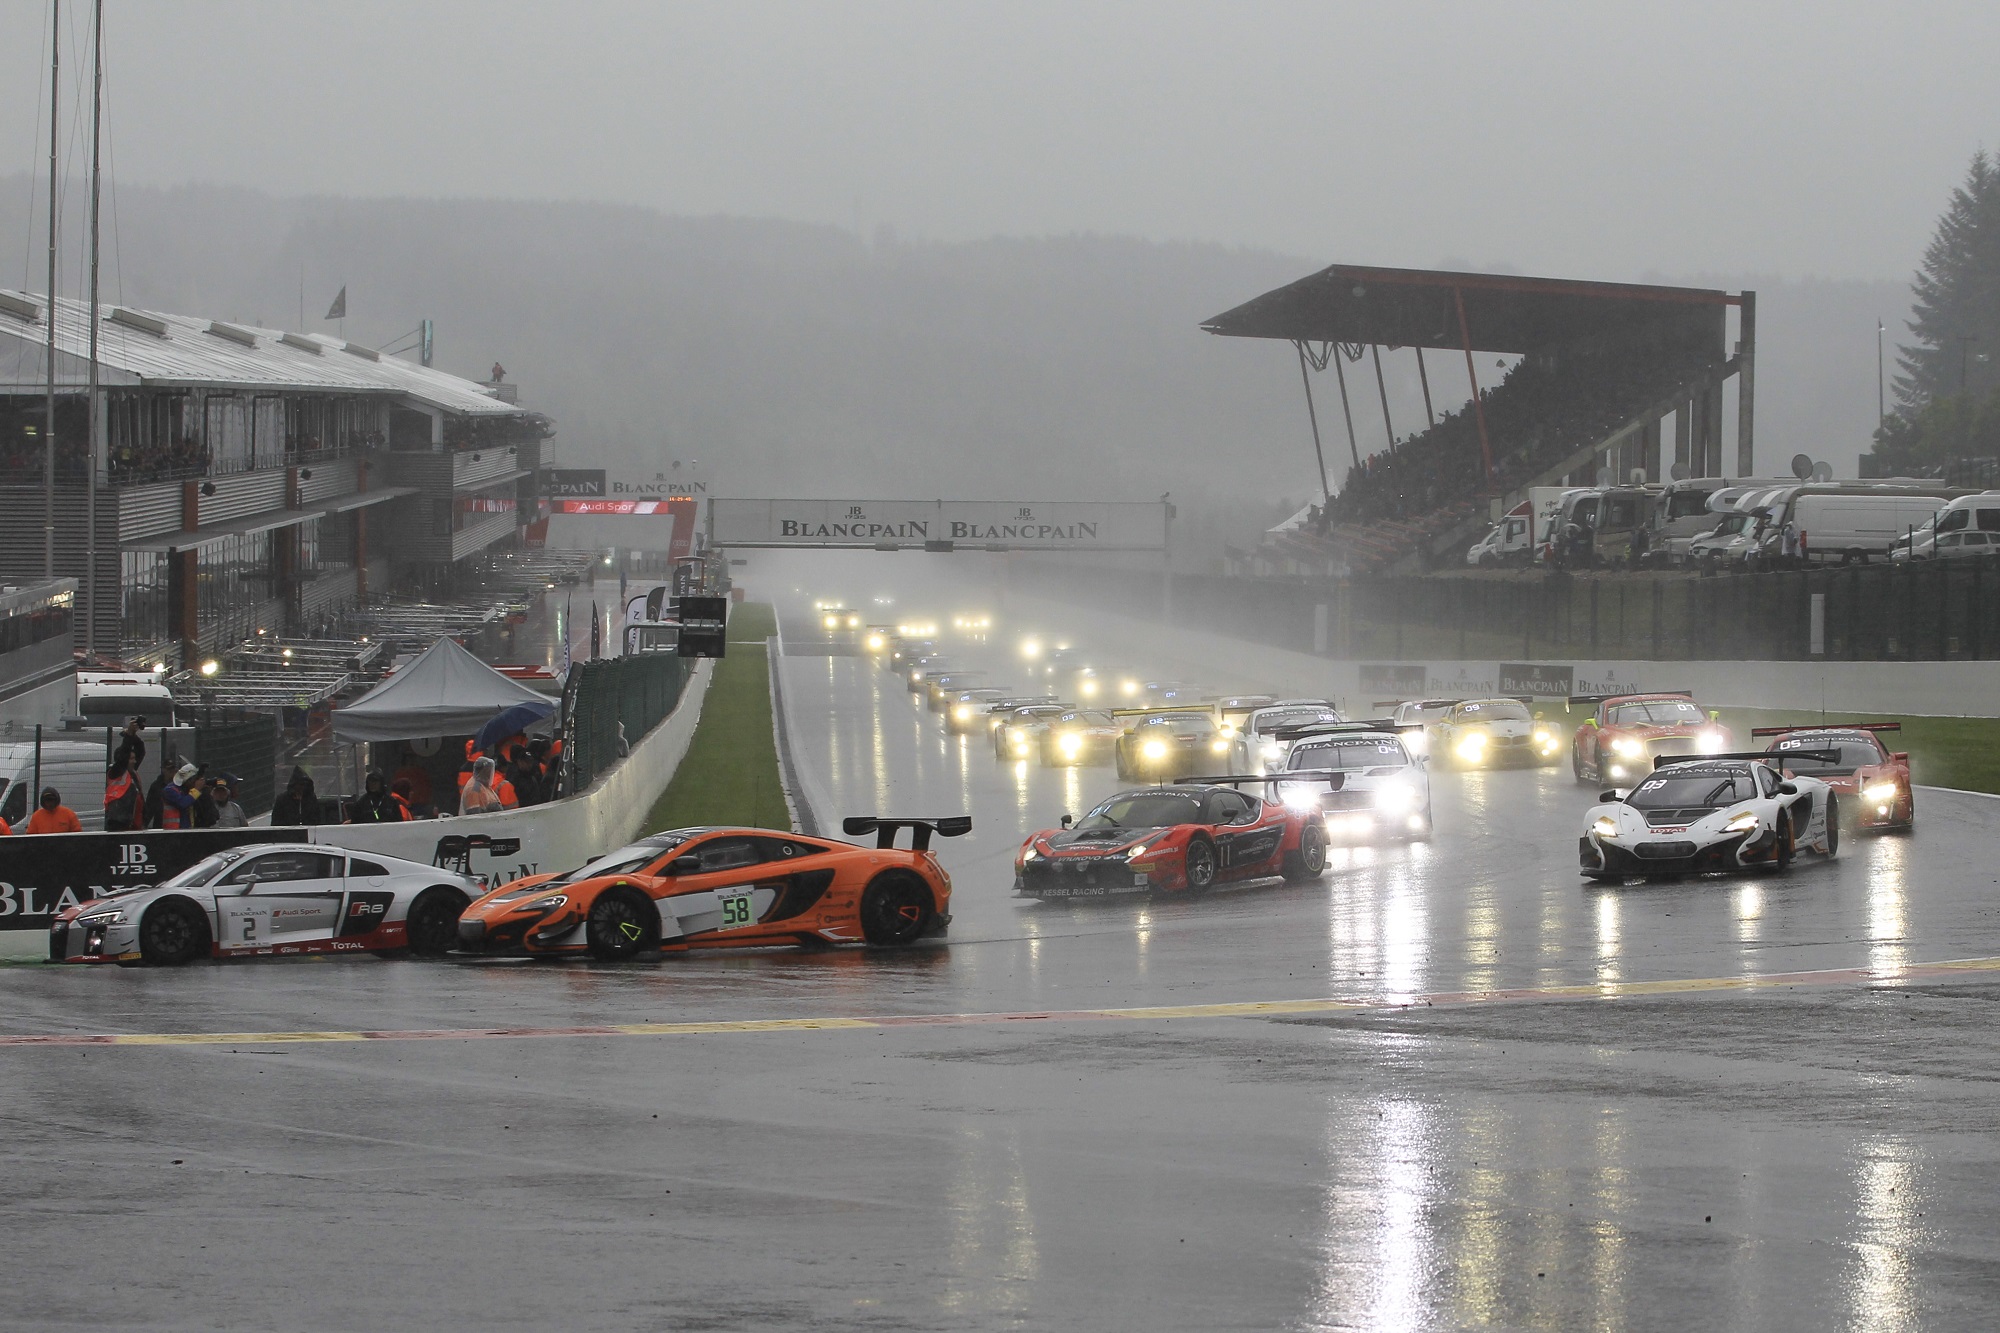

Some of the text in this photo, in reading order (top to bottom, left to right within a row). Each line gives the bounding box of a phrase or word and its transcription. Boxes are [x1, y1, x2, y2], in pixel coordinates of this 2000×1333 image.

[613, 482, 707, 493] BLANCPAIN
[579, 502, 605, 510] Audi
[781, 520, 929, 538] BLANCPAIN
[950, 521, 1098, 539] BLANCPAIN
[1431, 678, 1493, 692] BLANCPAIN
[1503, 678, 1569, 693] BLANCPAIN
[1579, 680, 1638, 695] BLANCPAIN
[1378, 746, 1398, 754] 04
[1780, 740, 1801, 750] 05
[1641, 779, 1668, 790] 03
[110, 865, 157, 875] 1735
[717, 890, 754, 900] BLANCPAIN
[1042, 888, 1070, 896] KESSEL
[1072, 887, 1104, 896] RACING
[300, 908, 321, 917] Sport
[358, 903, 384, 914] R8
[722, 898, 749, 924] 58
[243, 918, 256, 941] 2
